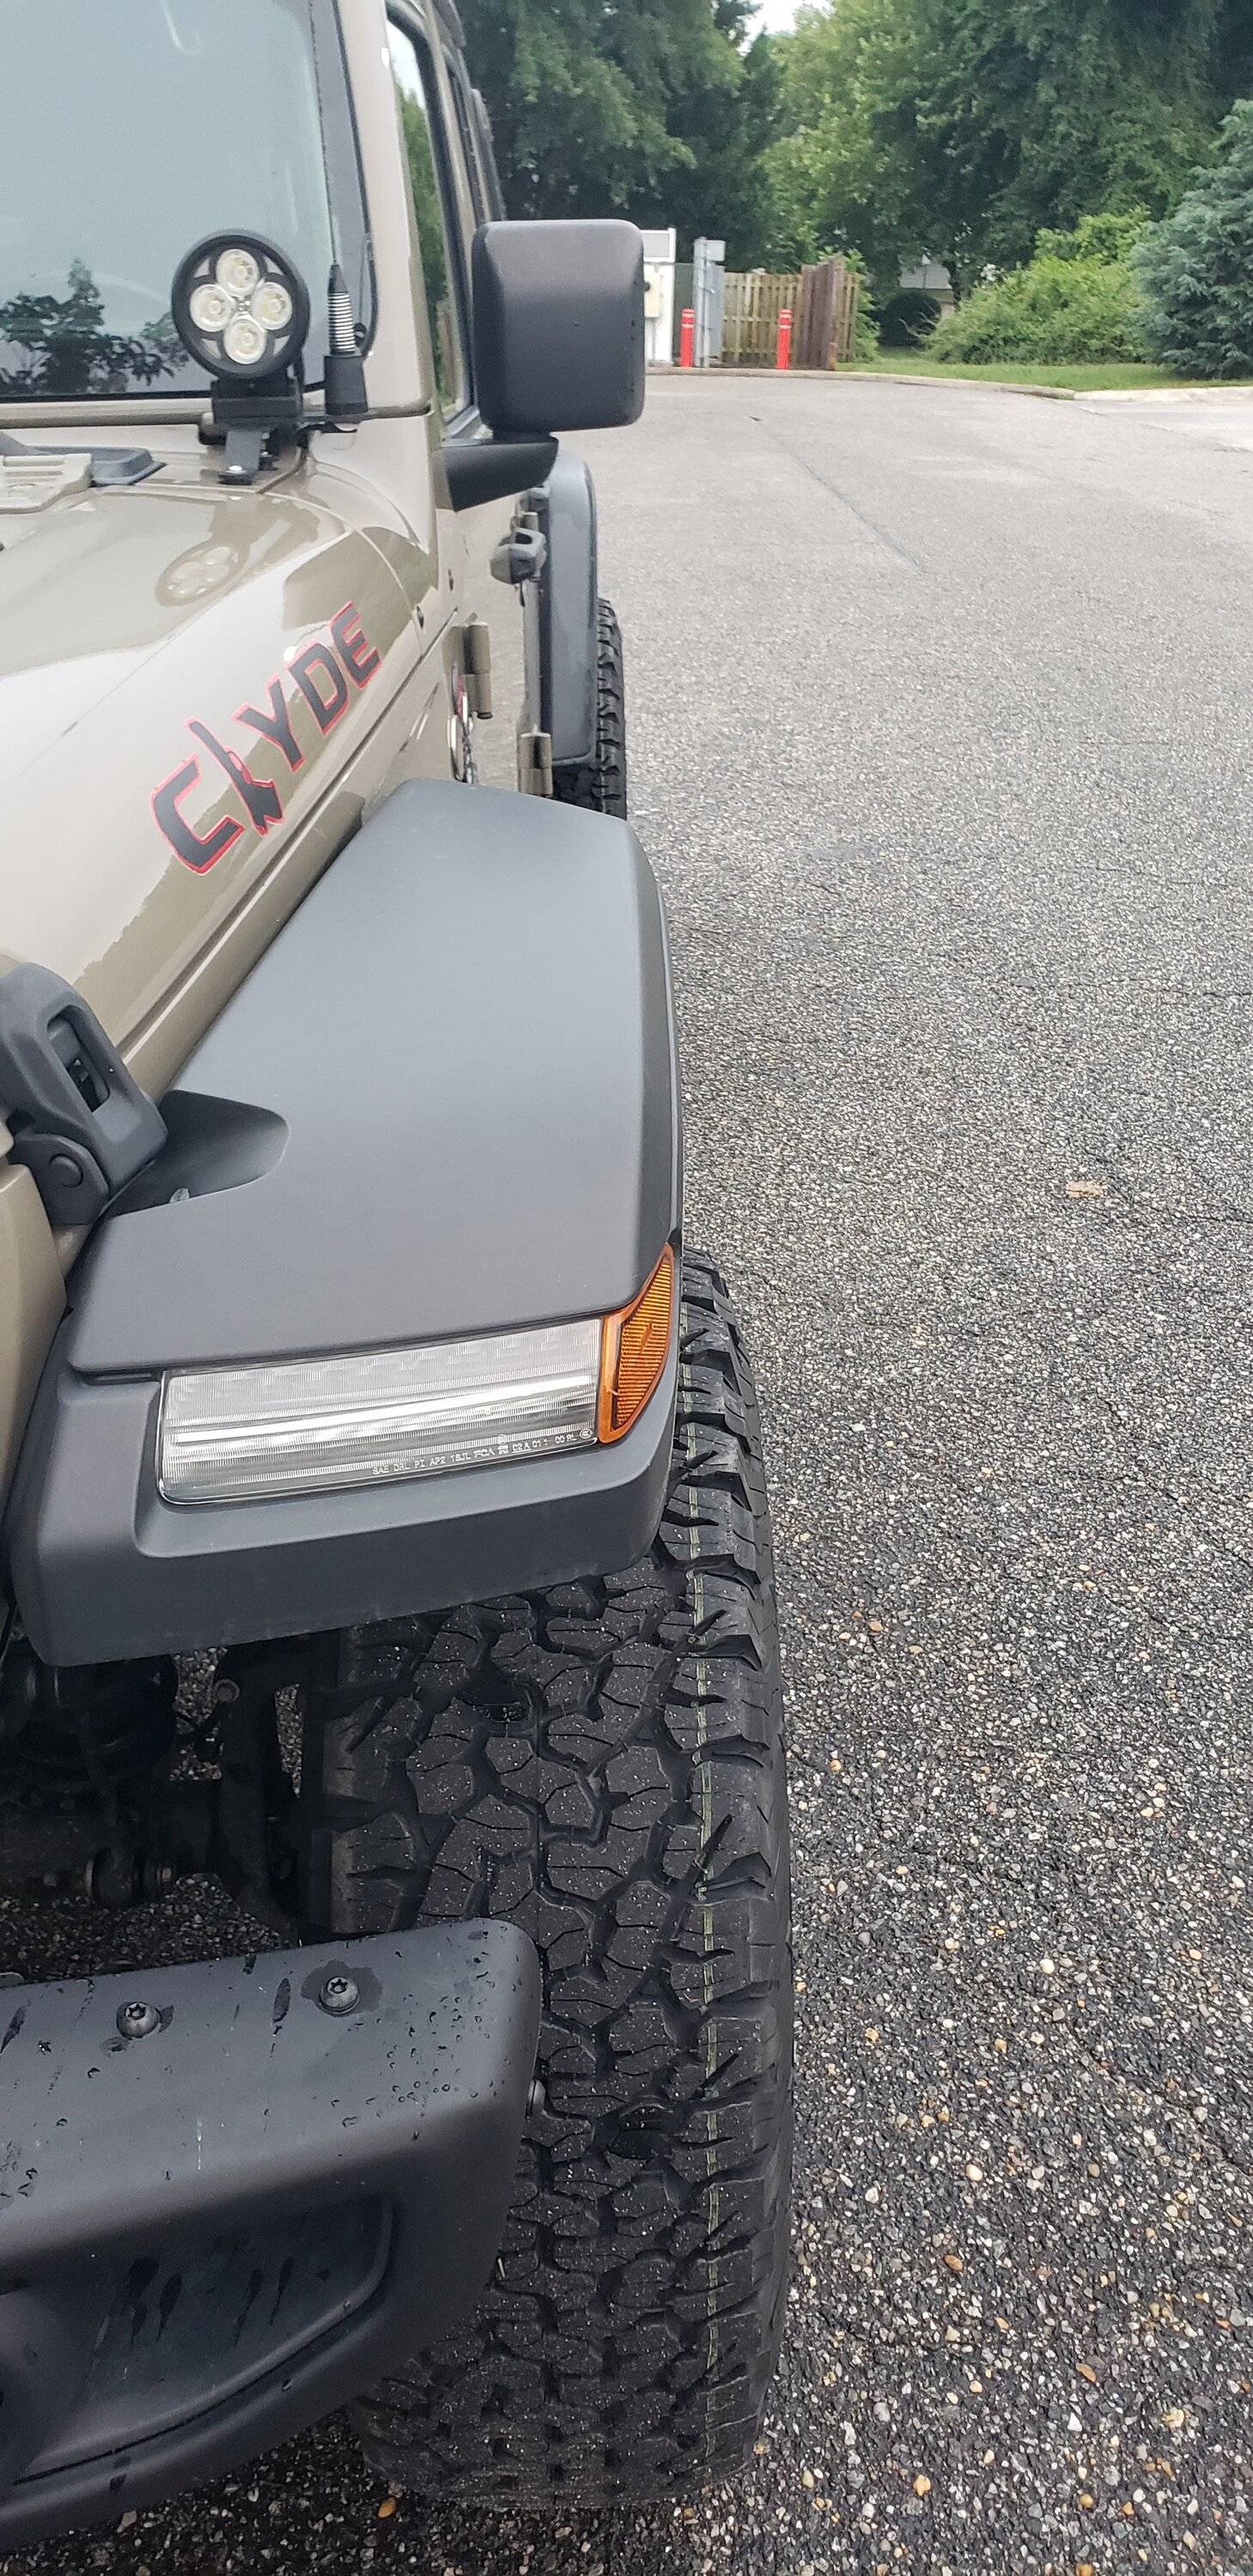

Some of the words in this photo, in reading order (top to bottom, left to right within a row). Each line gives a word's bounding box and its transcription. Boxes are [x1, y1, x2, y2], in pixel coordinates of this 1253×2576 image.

[150, 600, 383, 876] CLYDE
[372, 1465, 389, 1475] SAE
[393, 1463, 411, 1472] DRL
[429, 1456, 447, 1467] AP2
